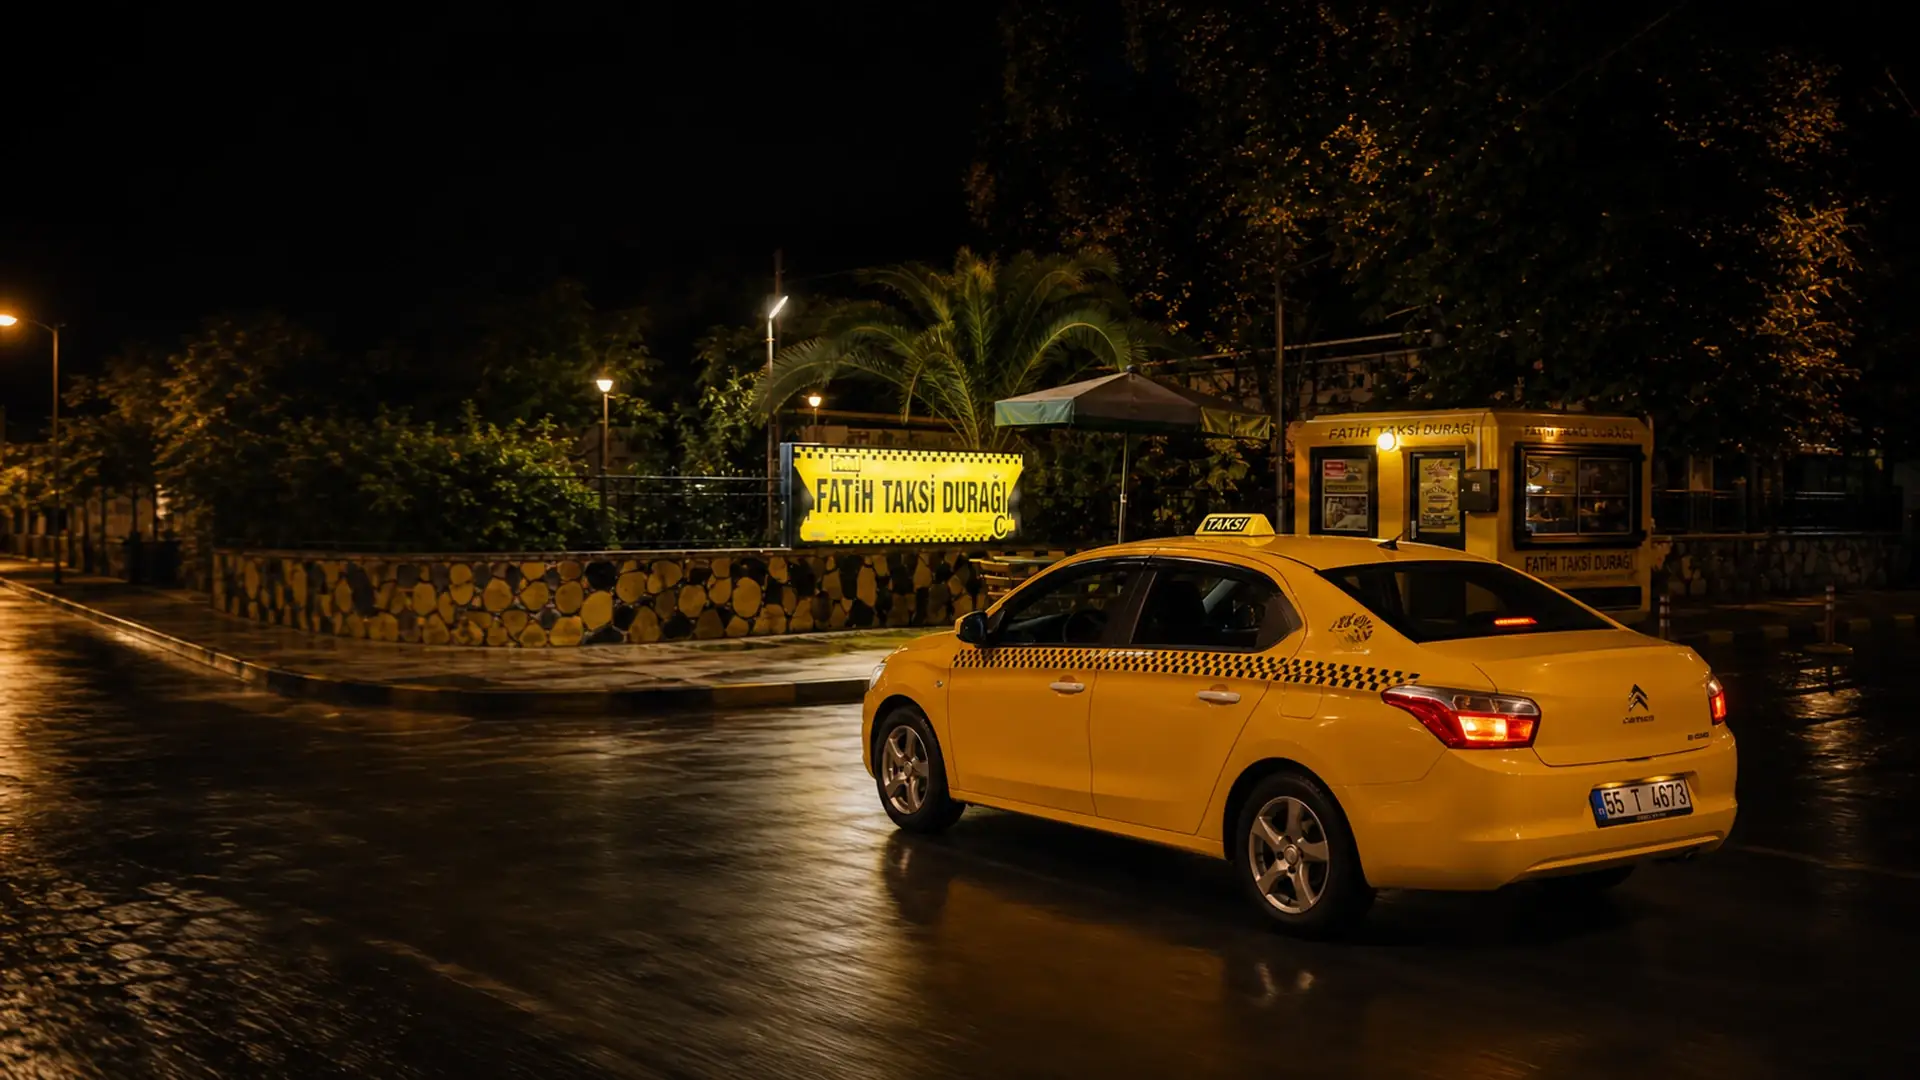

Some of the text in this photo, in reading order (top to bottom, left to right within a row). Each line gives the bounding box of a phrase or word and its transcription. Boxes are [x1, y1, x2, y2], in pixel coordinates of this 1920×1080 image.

[1329, 423, 1370, 439] FATİH
[816, 473, 1007, 513] FATİH TAKSİ DURAĞI
[1207, 518, 1248, 530] TAKSI
[1525, 552, 1557, 573] FATİH
[1561, 552, 1592, 571] TAKSİ
[1604, 782, 1687, 815] 55 T 4673
